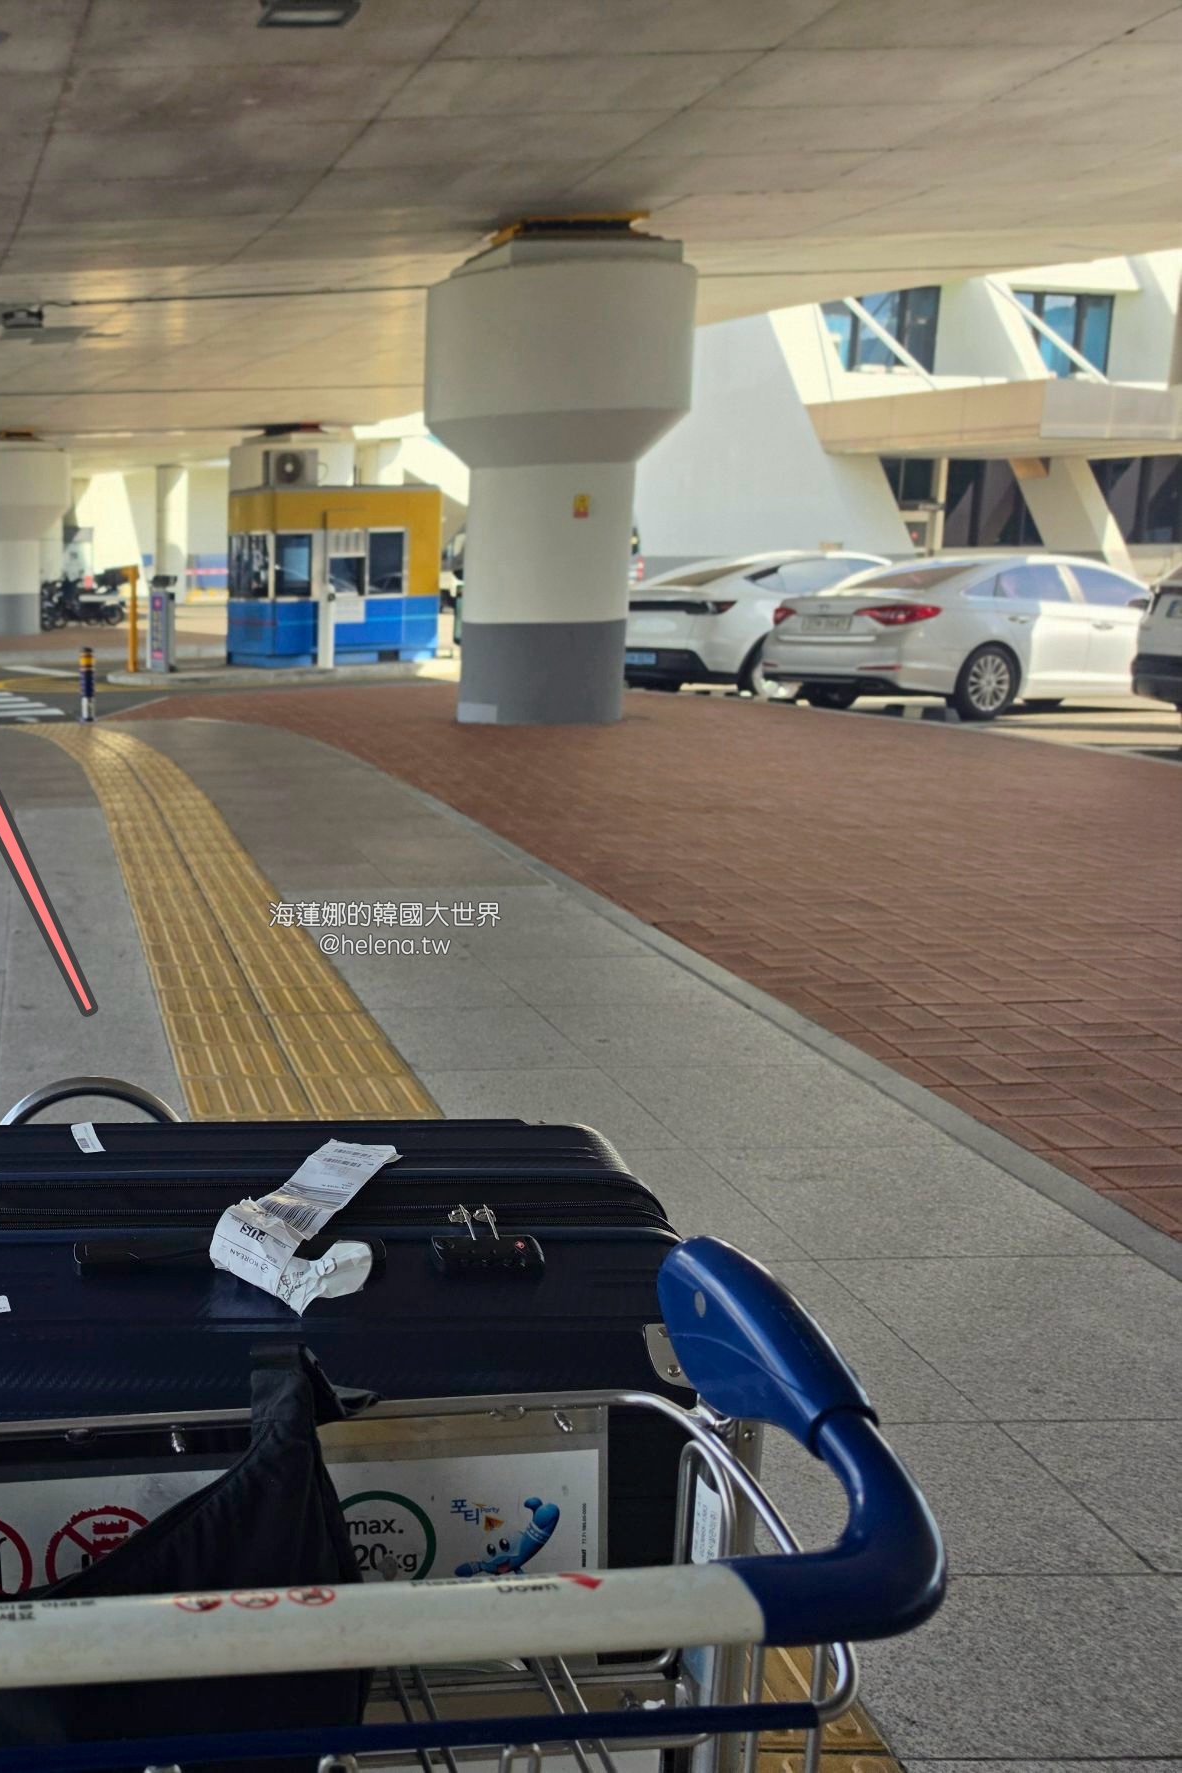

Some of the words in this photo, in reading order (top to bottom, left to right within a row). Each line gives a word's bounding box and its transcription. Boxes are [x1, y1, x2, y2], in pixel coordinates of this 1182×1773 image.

[240, 1223, 268, 1243] PUS
[229, 1247, 259, 1269] KOREAN
[347, 1518, 404, 1535] max.
[497, 1583, 559, 1594] Down
